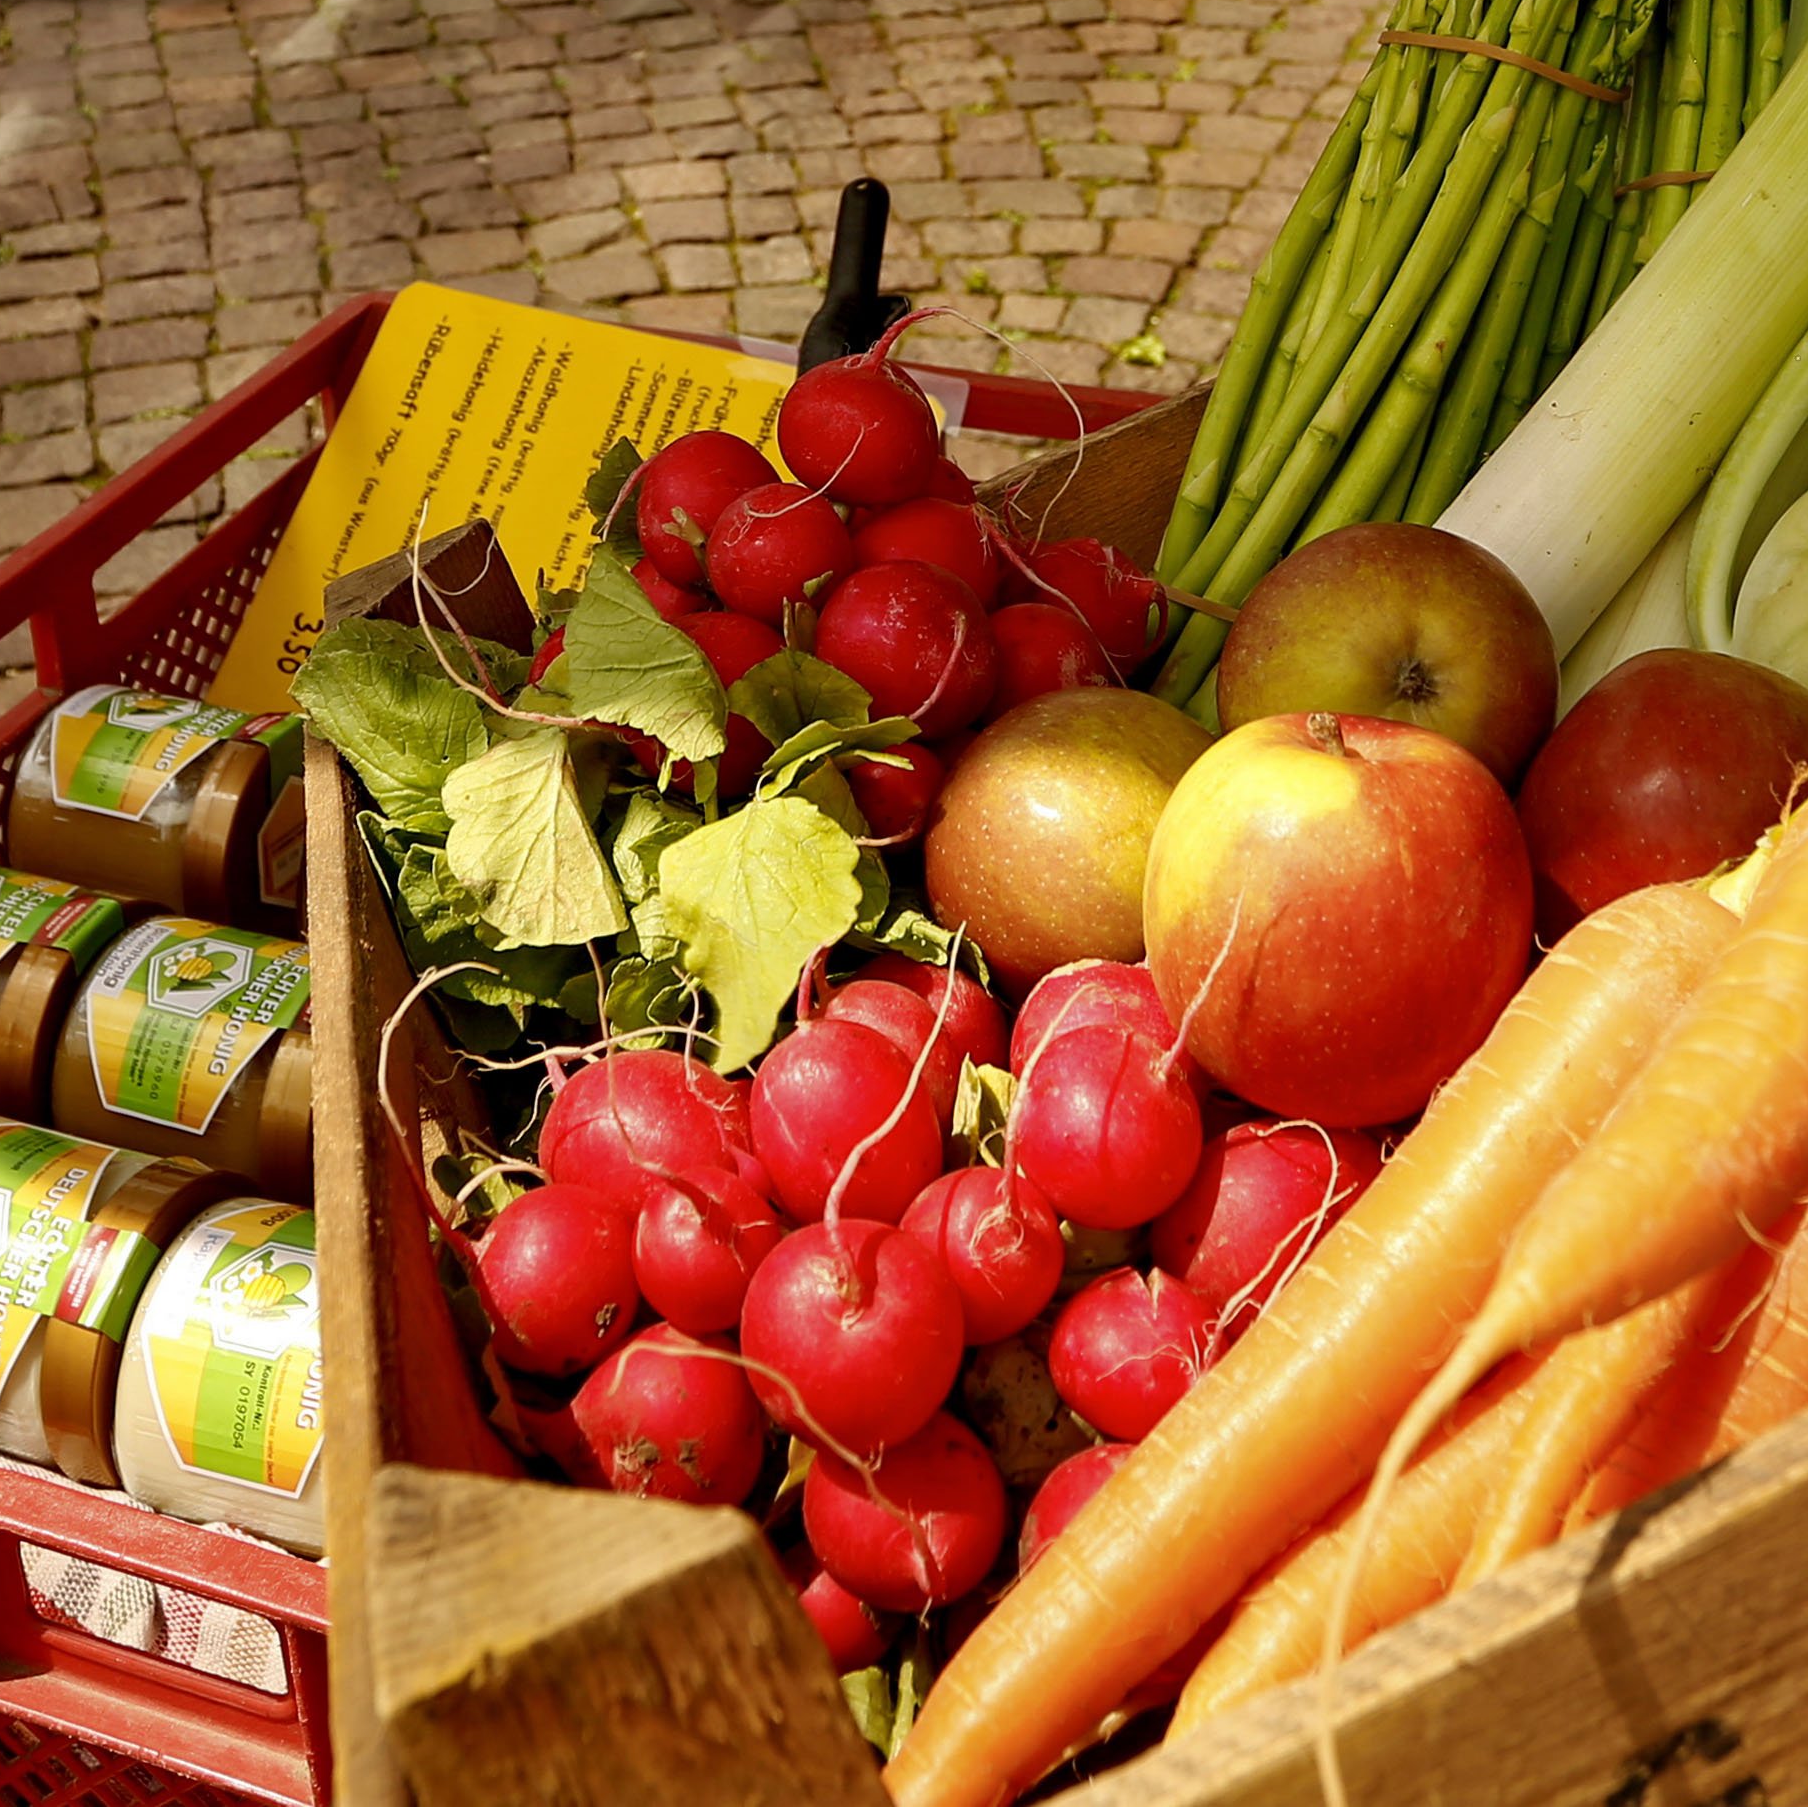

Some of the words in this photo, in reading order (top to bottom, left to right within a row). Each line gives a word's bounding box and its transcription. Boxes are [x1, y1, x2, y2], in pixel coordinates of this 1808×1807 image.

[253, 965, 308, 1025] ECHTER
[209, 1005, 246, 1076] HONIG
[0, 1168, 88, 1285] DEUTSCHER
[16, 1216, 72, 1309] ECHTER
[244, 1360, 257, 1379] SY
[232, 1386, 251, 1450] 0197054
